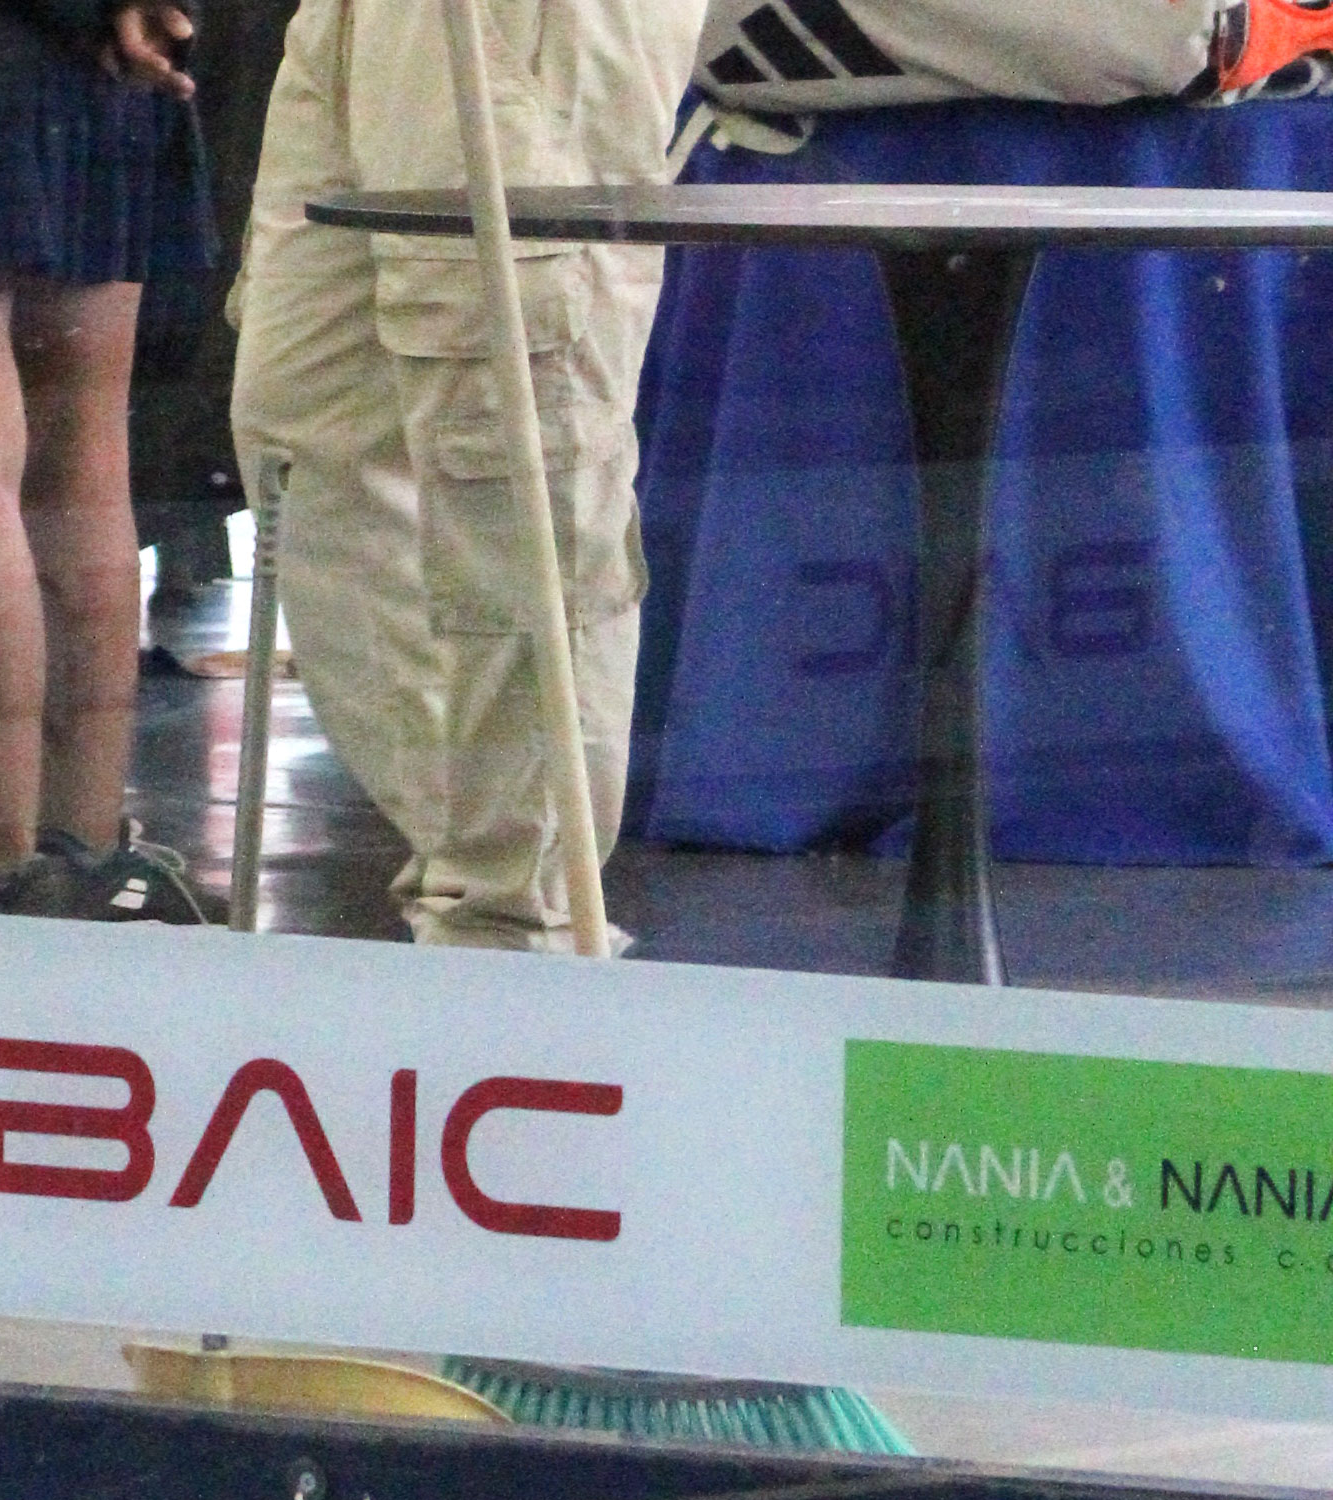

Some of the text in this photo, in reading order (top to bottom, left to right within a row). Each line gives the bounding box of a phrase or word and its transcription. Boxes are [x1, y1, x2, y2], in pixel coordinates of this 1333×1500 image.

[887, 1137, 1087, 1204] NANIA
[1104, 1157, 1133, 1209] &
[887, 1215, 1236, 1266] construcciones
